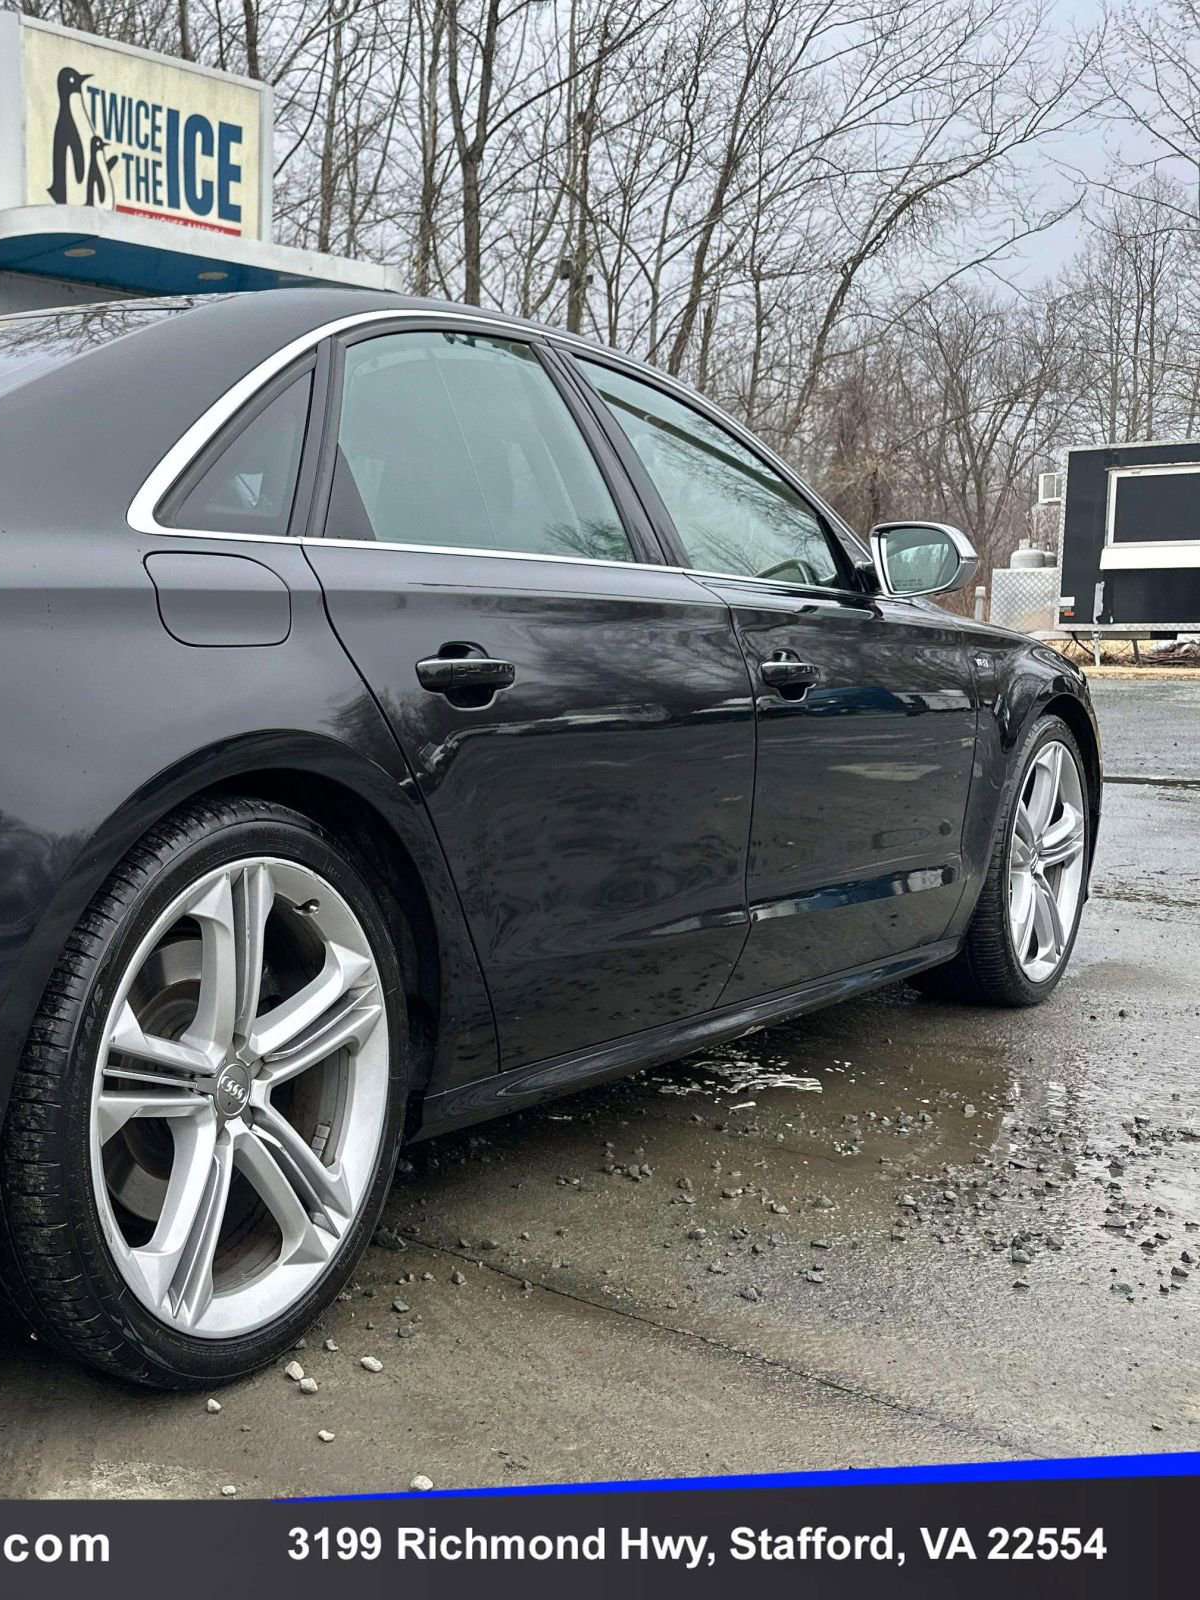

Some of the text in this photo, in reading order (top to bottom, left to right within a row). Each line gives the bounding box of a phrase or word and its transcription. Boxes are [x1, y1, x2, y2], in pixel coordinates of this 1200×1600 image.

[86, 86, 163, 154] TWICE
[121, 152, 164, 207] THE
[166, 107, 243, 223] ICE
